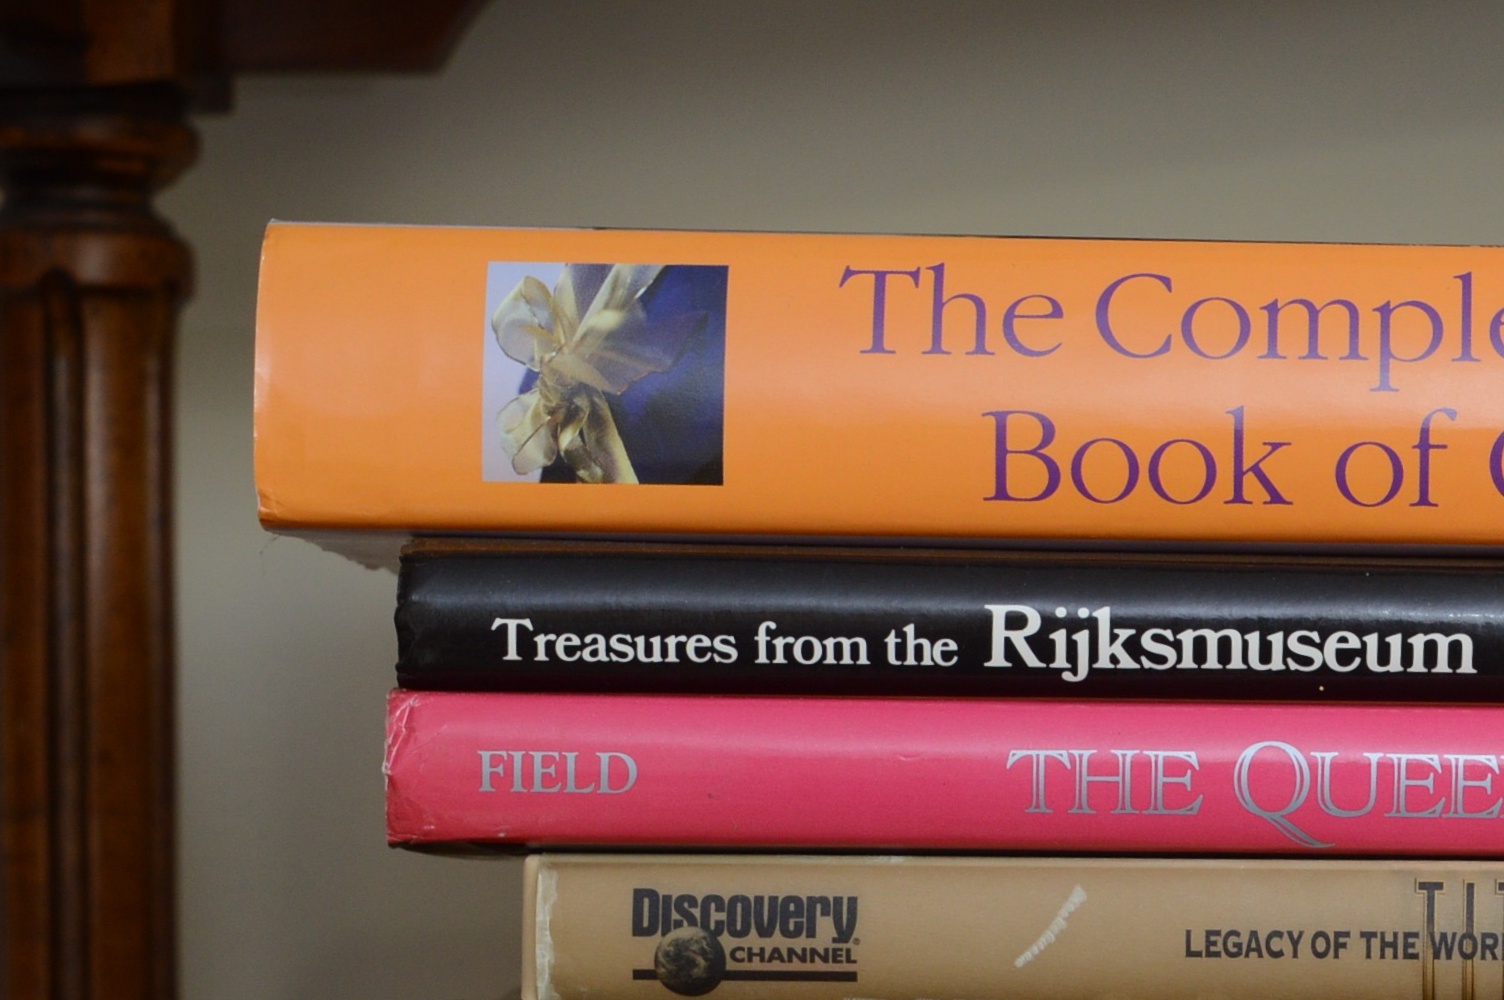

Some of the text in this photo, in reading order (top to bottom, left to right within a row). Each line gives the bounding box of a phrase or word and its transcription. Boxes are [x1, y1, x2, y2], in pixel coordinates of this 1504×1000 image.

[838, 262, 1064, 357] The
[982, 404, 1294, 506] Book
[1335, 408, 1458, 508] of
[491, 616, 738, 664] Treasures
[753, 621, 871, 667] from
[885, 624, 959, 668] the
[984, 603, 1476, 683] Rijksmuseum
[476, 749, 639, 795] FIELD
[1006, 748, 1204, 816] THE
[729, 946, 858, 965] CHANNEL
[1184, 928, 1304, 961] LEGACY
[1311, 930, 1351, 961] OF
[1360, 931, 1420, 962] THE
